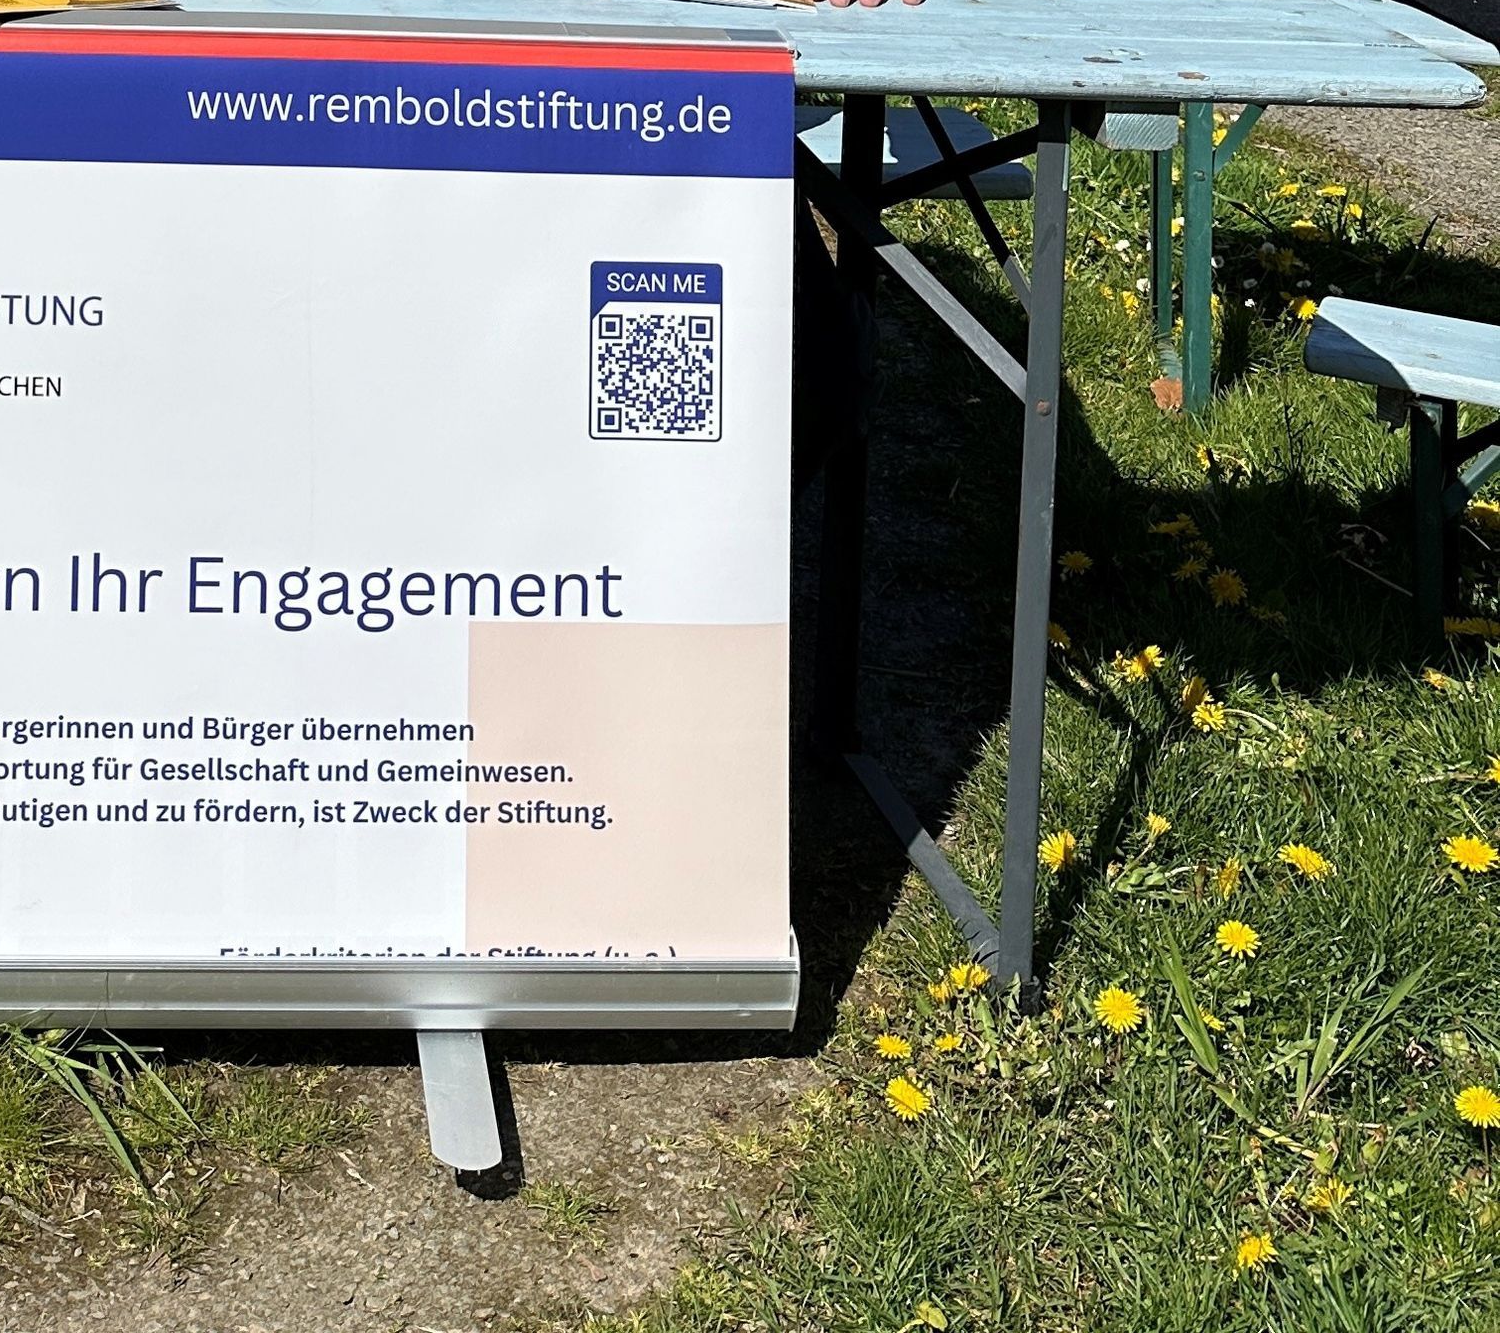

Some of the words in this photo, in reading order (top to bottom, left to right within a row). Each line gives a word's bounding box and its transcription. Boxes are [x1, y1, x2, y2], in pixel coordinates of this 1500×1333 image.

[187, 86, 732, 143] www.remboldstiftung.de
[606, 271, 666, 294] SCAN
[673, 273, 707, 294] ME
[70, 552, 164, 613] Ihr
[188, 556, 623, 633] Engagement
[142, 716, 194, 740] und
[203, 716, 295, 747] Bürger
[301, 717, 475, 742] übernehmen
[91, 756, 133, 781] für
[140, 757, 310, 783] Gesellschaft
[317, 758, 368, 782] und
[377, 758, 574, 784] Gemeinwesen.
[96, 798, 148, 823] und
[155, 805, 185, 823] zu
[193, 798, 305, 829] fördern,
[313, 799, 346, 824] ist
[352, 799, 438, 824] Zweck
[445, 799, 491, 824] der
[497, 800, 614, 830] Stiftung.
